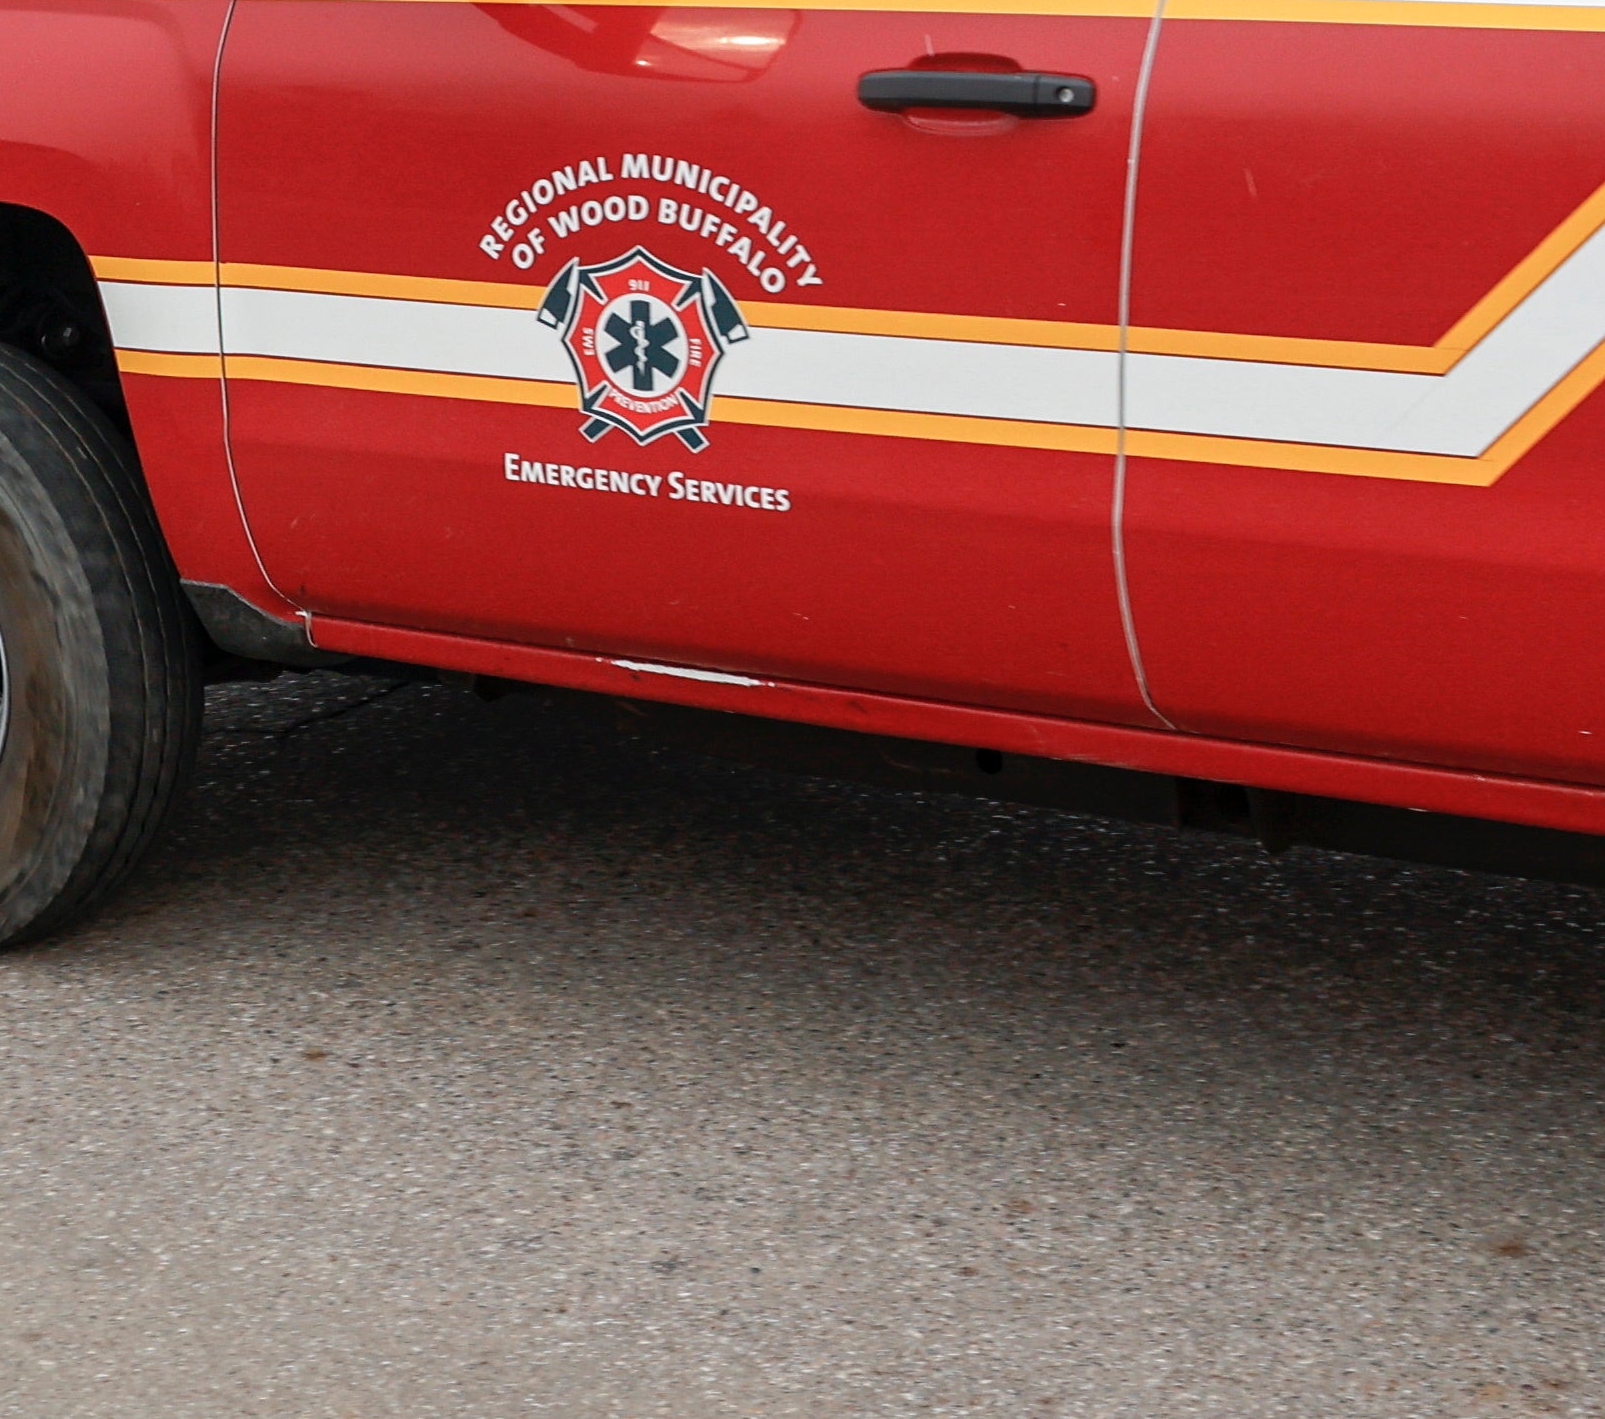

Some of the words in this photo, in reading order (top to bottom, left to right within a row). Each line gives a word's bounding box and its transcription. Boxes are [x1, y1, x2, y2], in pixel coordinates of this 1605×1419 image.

[478, 156, 615, 260] REGIONAL
[621, 153, 824, 288] MUNICIPALITY
[511, 228, 546, 270] OF
[547, 195, 650, 239] WOOD
[657, 198, 787, 294] BUFFALO
[627, 279, 651, 292] 911
[581, 327, 595, 356] EMS
[609, 388, 679, 414] PREVENTION
